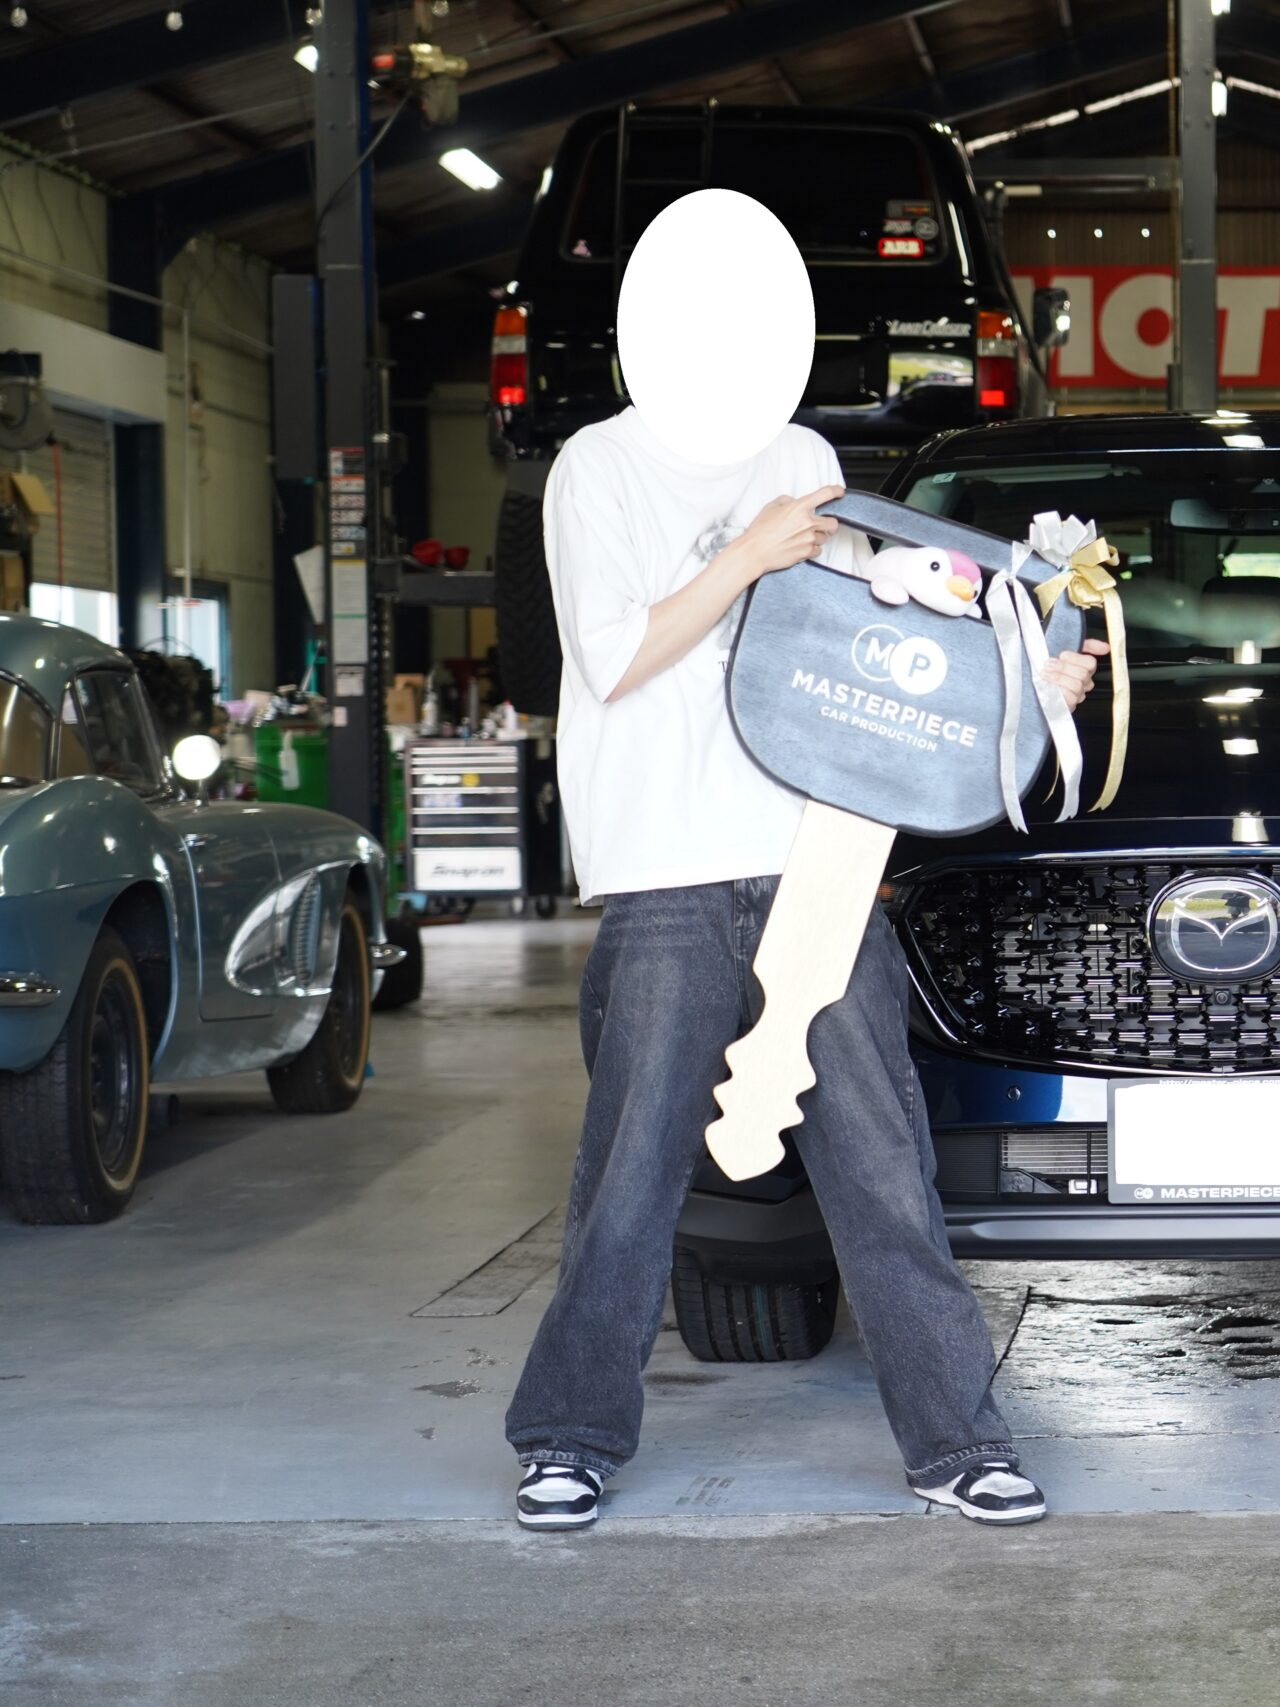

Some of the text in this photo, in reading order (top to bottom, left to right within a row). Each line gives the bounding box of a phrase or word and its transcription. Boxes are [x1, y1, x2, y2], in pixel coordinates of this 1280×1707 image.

[791, 668, 978, 748] MASTERPIECE
[820, 705, 937, 753] CAR PRODUCTION
